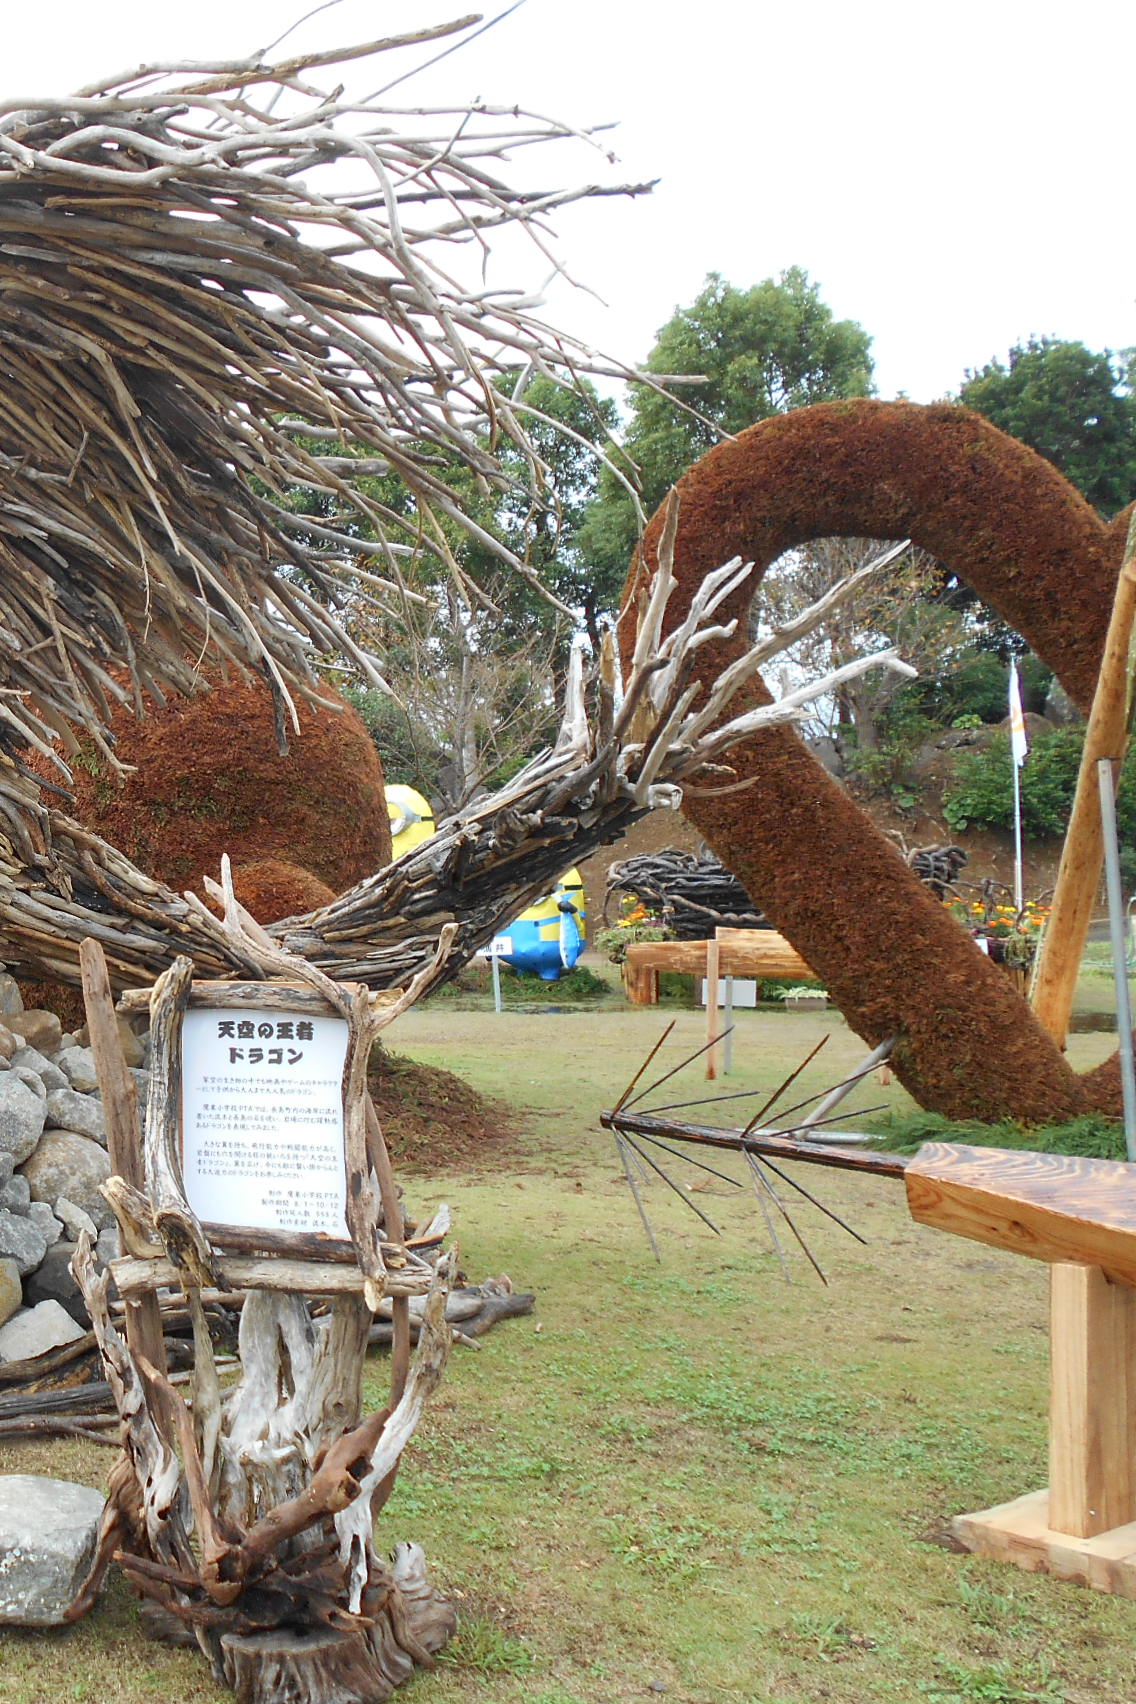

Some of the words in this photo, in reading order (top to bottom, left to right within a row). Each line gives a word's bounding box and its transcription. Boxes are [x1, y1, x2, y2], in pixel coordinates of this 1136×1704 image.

[218, 1020, 314, 1041] 天空の王者
[228, 1047, 304, 1065] ドラゴン
